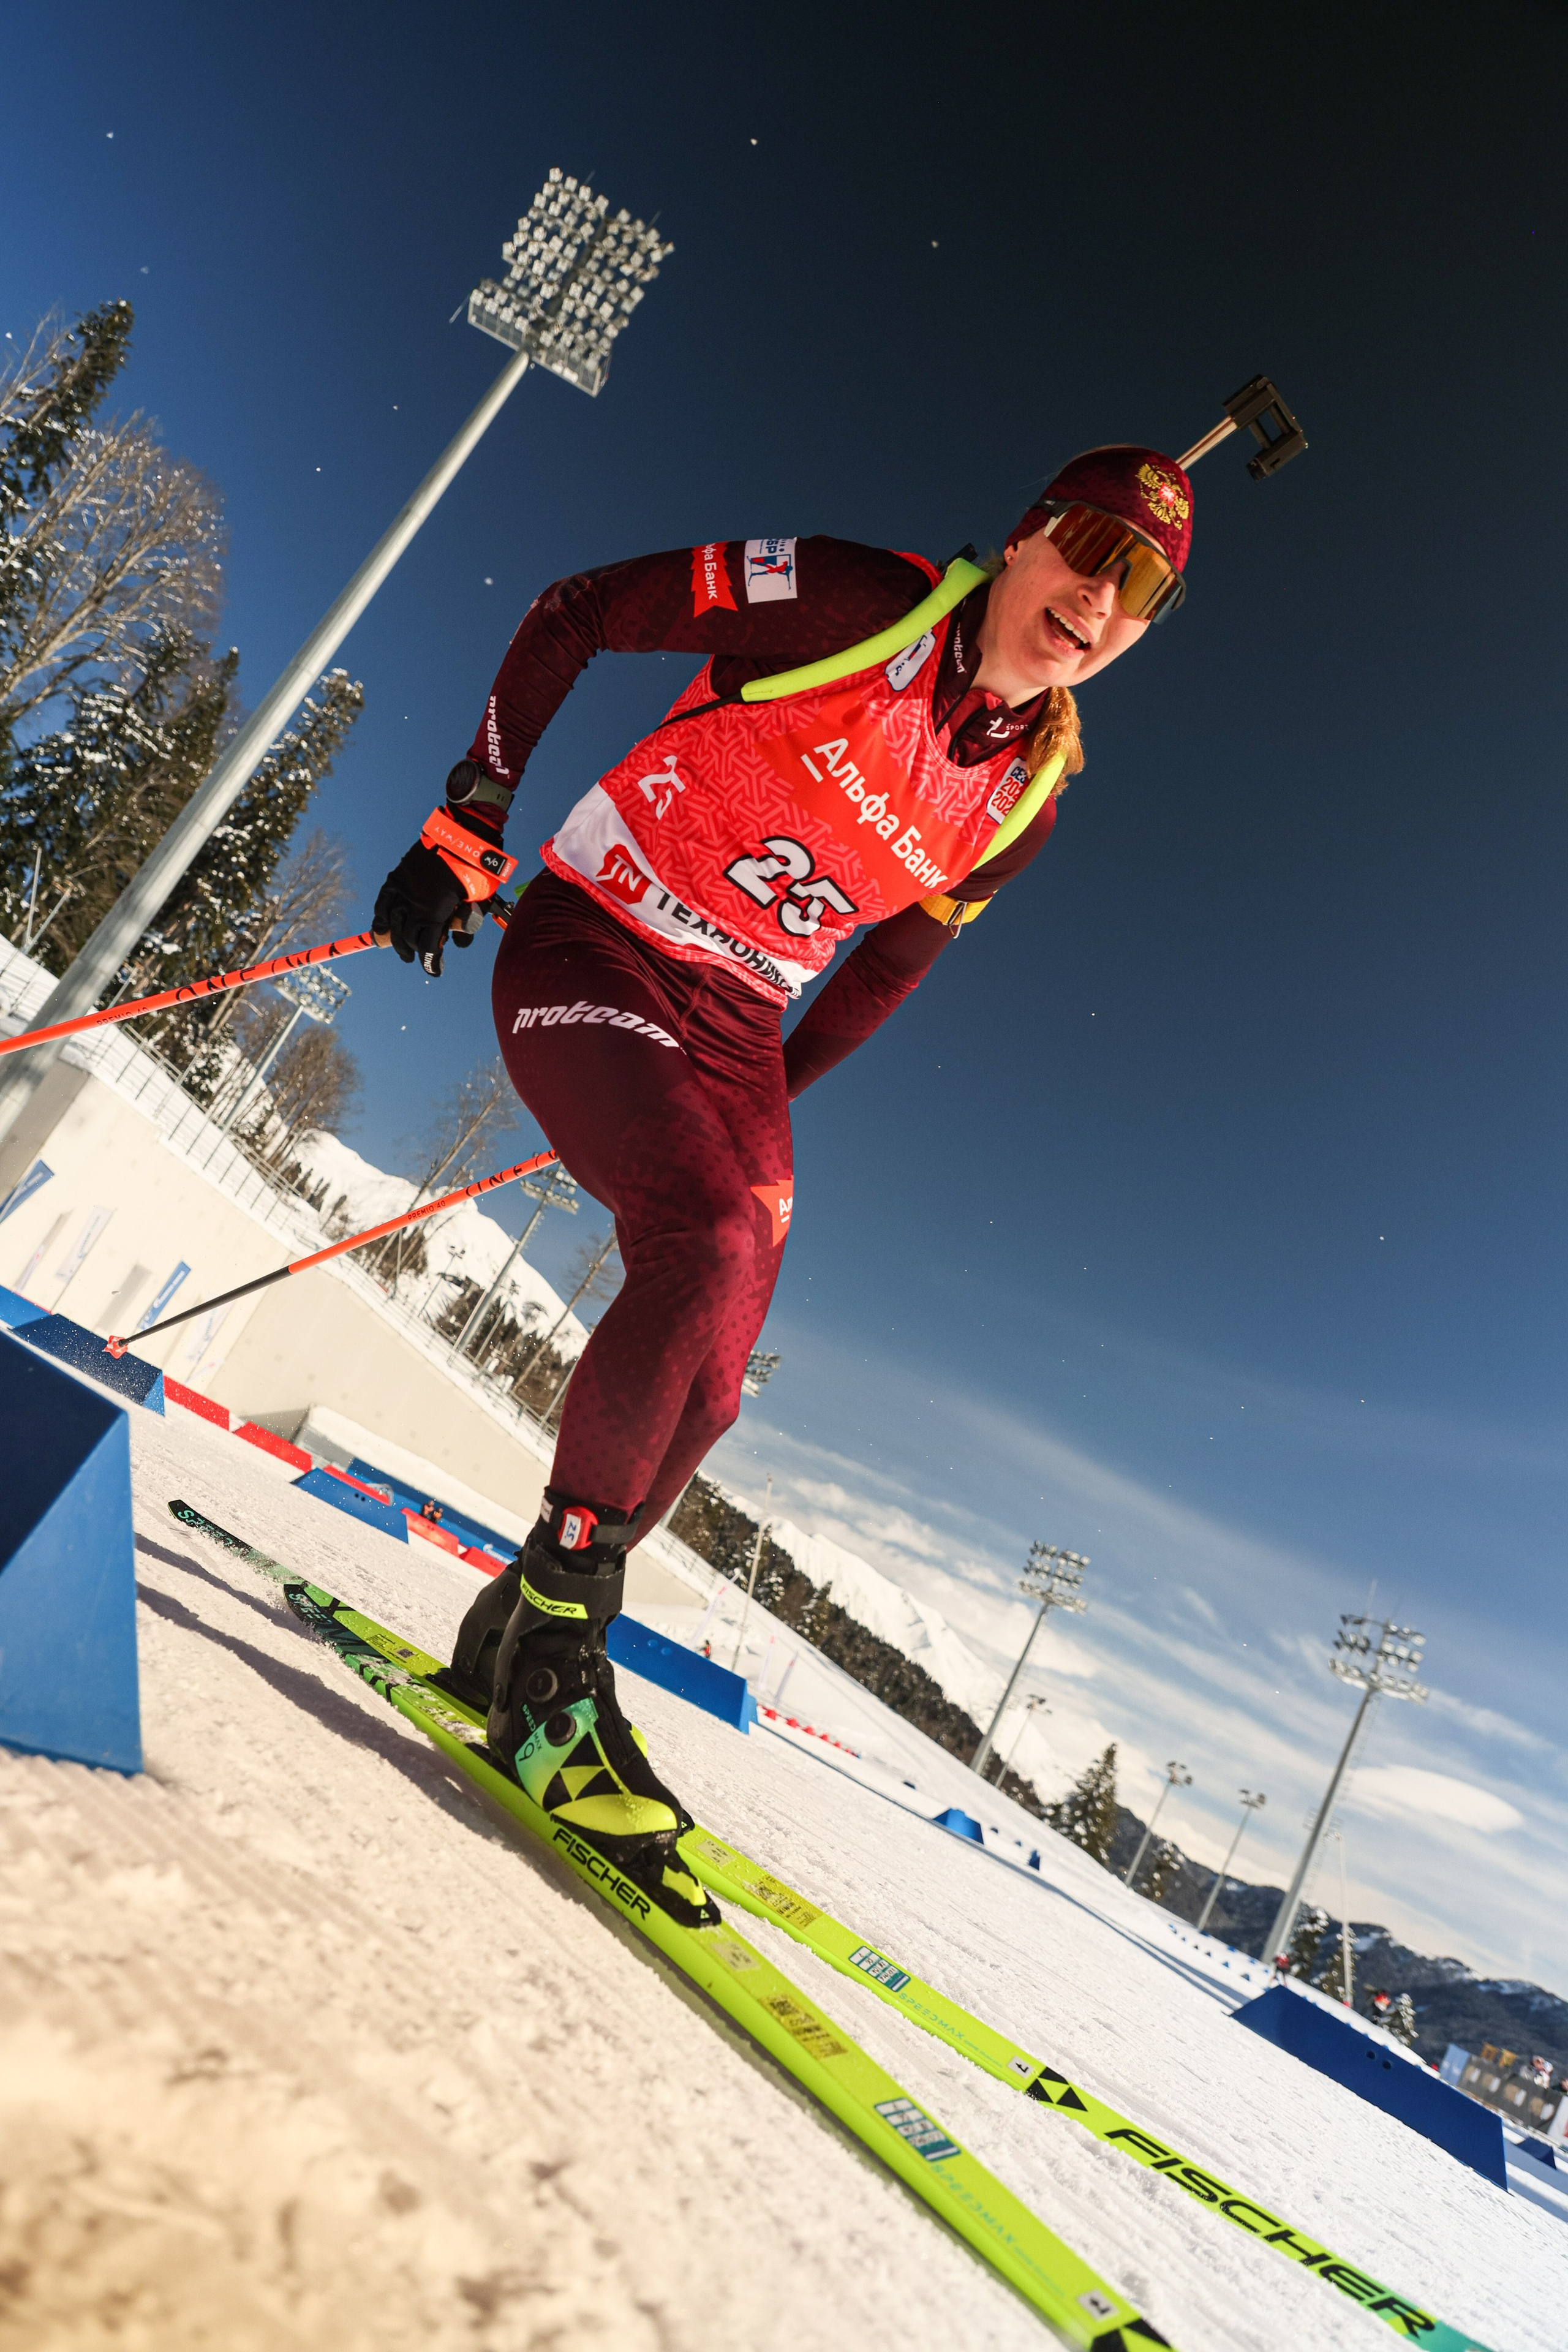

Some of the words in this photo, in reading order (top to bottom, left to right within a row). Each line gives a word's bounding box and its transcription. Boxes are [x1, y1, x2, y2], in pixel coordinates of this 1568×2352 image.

[704, 560, 718, 600] Банк
[813, 737, 901, 841] Альфа
[890, 825, 949, 889] Банк
[501, 862, 512, 878] RIGHT
[722, 835, 859, 938] 25
[512, 1000, 681, 1049] proteam
[407, 1205, 434, 1221] PREMIO
[437, 1199, 447, 1208] 40
[521, 1581, 577, 1615] FISCHER
[551, 1827, 652, 1921] FISCHER
[899, 1992, 965, 2041] SPEEDMAX
[1104, 2127, 1436, 2338] FISCHER
